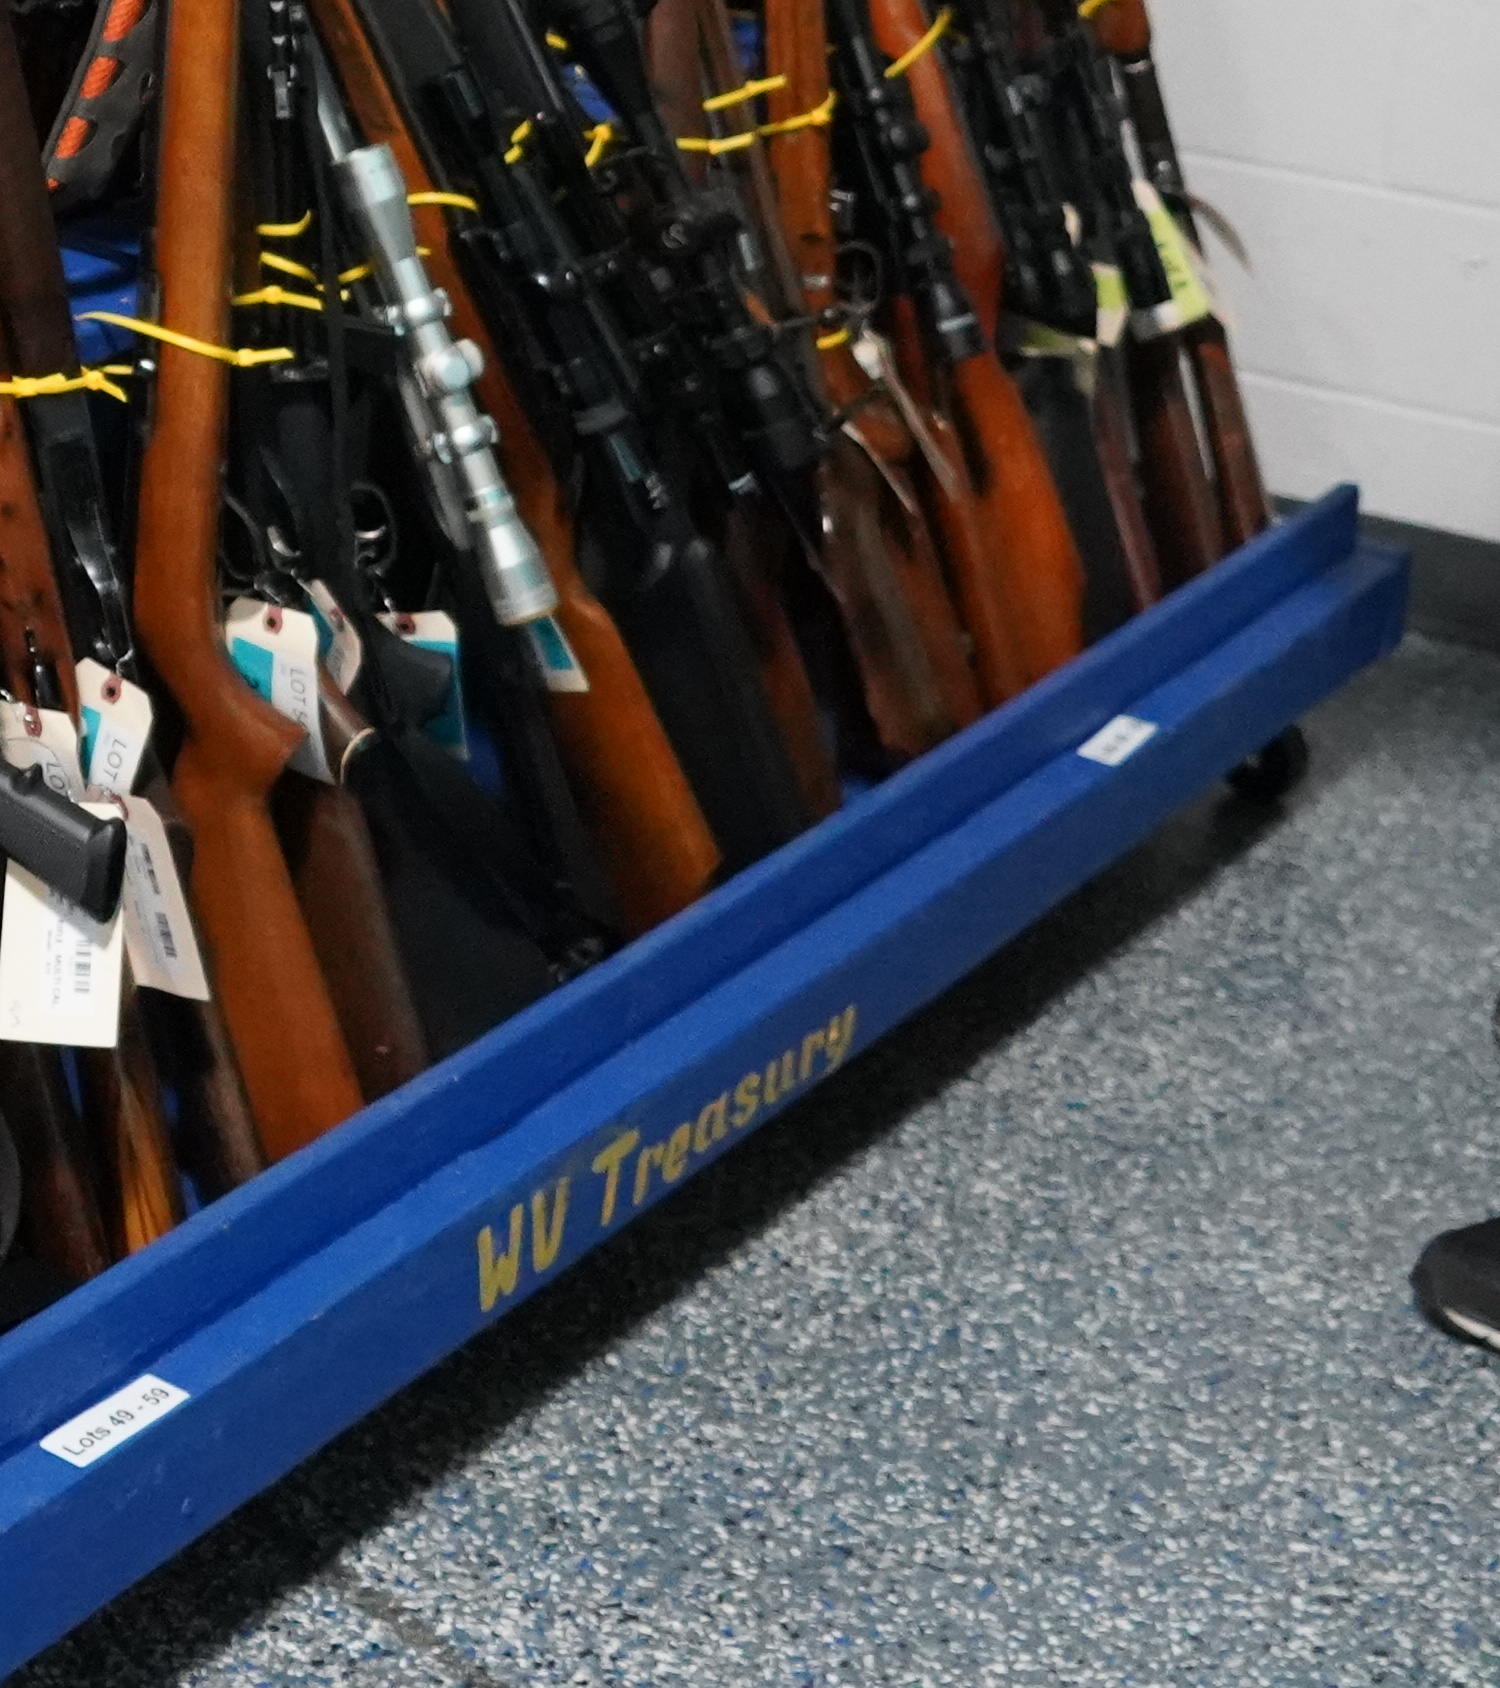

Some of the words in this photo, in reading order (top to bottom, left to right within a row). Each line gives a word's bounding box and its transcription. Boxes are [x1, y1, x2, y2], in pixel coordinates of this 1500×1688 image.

[290, 668, 307, 707] LOT
[46, 762, 66, 792] LO
[104, 739, 127, 782] LOT
[477, 1177, 569, 1312] WV
[592, 1004, 855, 1226] Treasury
[62, 1427, 111, 1456] Lots
[109, 1410, 135, 1426] 49
[142, 1388, 169, 1405] 59
